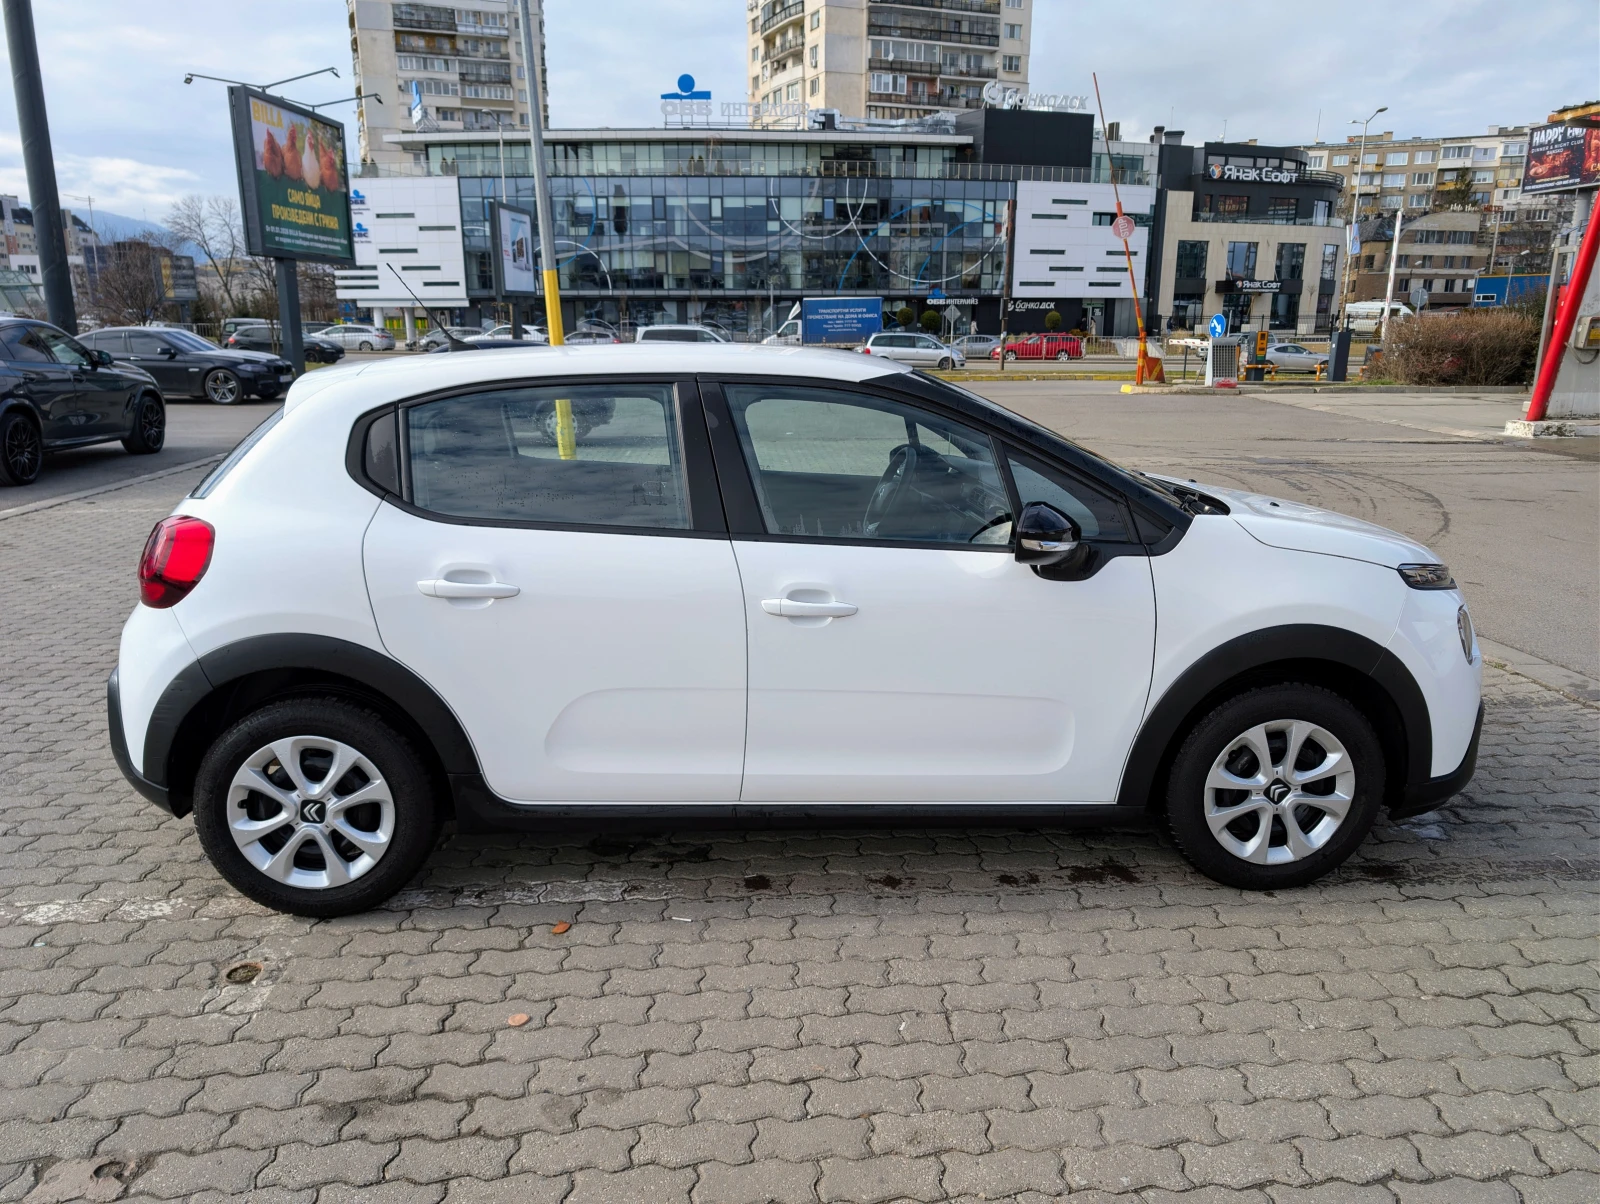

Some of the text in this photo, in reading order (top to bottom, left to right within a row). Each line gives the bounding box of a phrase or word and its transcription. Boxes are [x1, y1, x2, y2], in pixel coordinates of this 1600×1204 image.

[252, 101, 283, 128] BILLA
[660, 101, 712, 116] ОББ
[1532, 126, 1565, 147] HAPPY
[1224, 165, 1298, 184] Янак Софт
[287, 188, 321, 210] САМО ЯЙЦА
[271, 203, 314, 226] ПРОИЗВЕДЕНИ
[319, 213, 339, 230] ГРИЖА
[1118, 218, 1129, 238] STOP
[946, 297, 979, 305] ИНТЕРЛИЙЗ
[1015, 300, 1055, 310] банка ДСК
